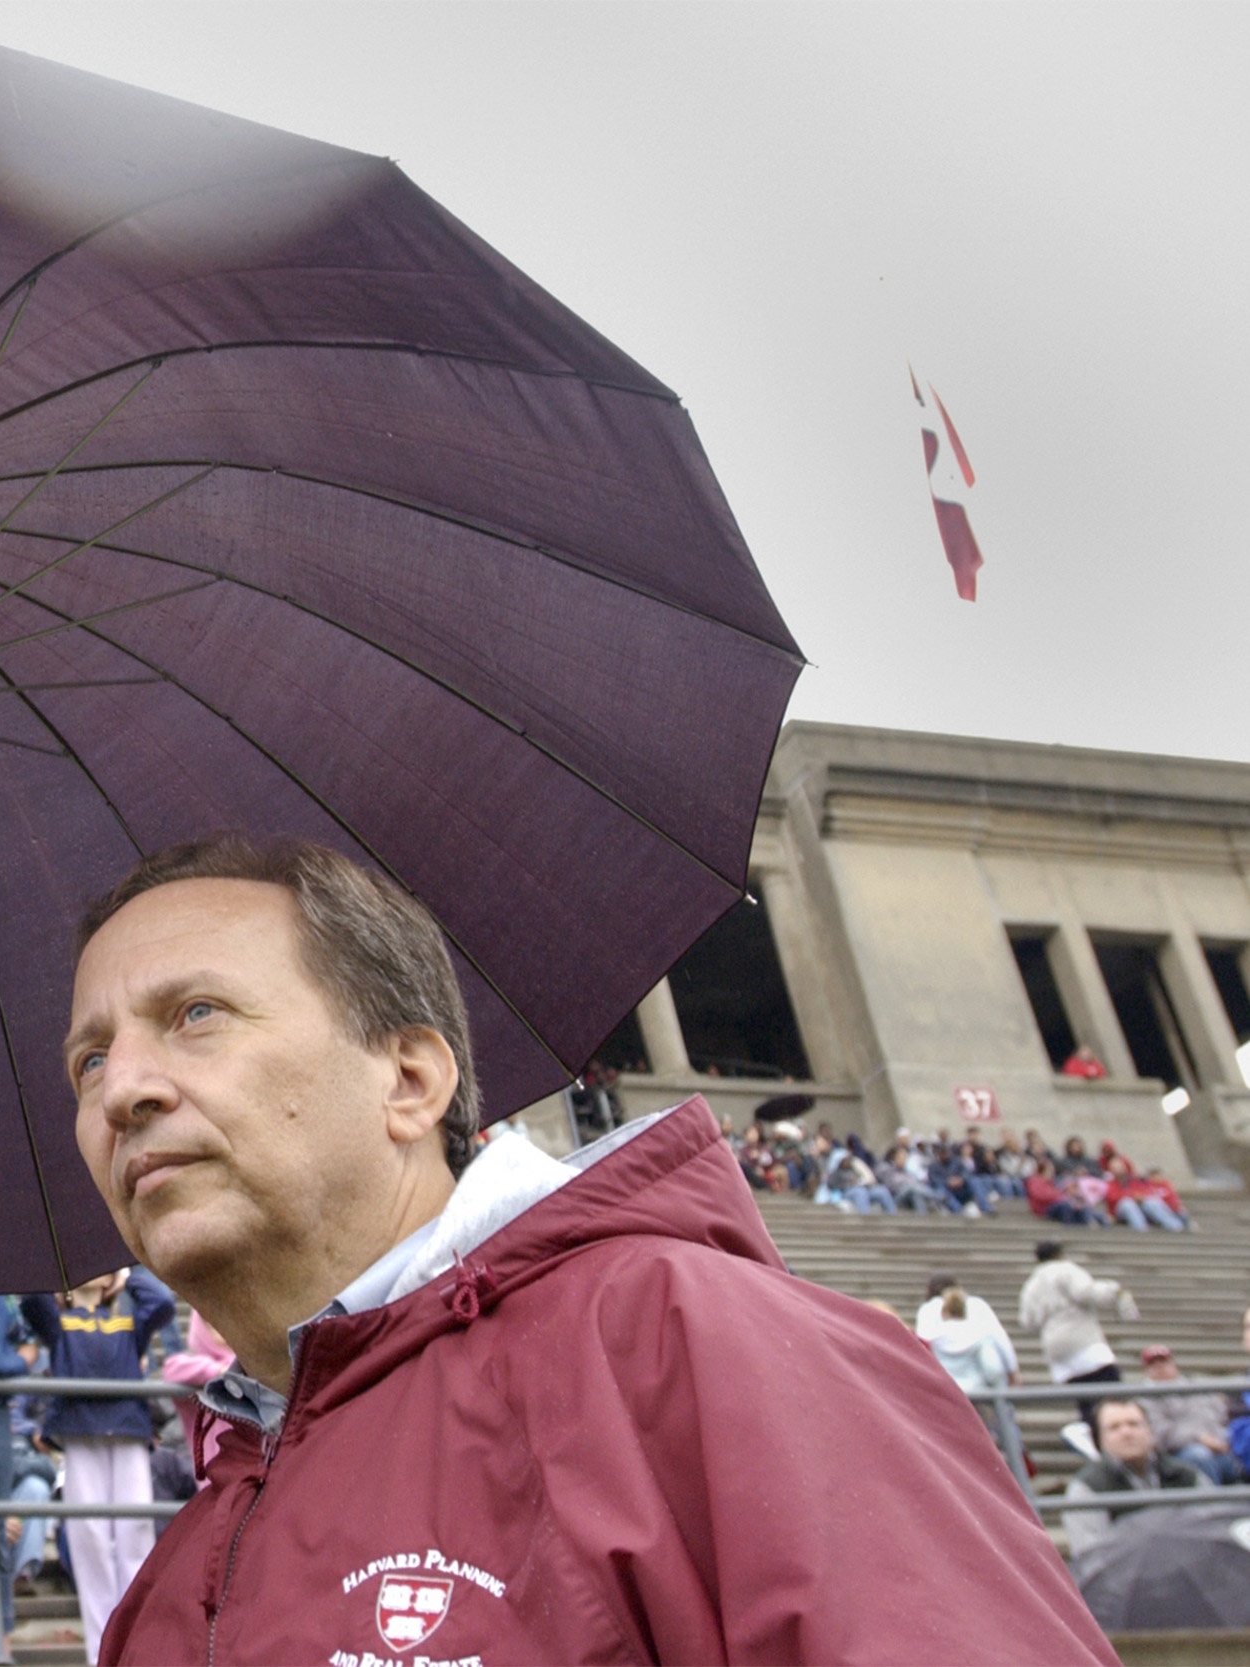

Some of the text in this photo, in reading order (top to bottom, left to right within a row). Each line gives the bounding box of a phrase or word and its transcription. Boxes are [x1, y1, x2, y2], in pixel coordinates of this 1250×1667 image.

[959, 1088, 991, 1119] 37
[342, 1549, 506, 1598] HARVARD PLANNING
